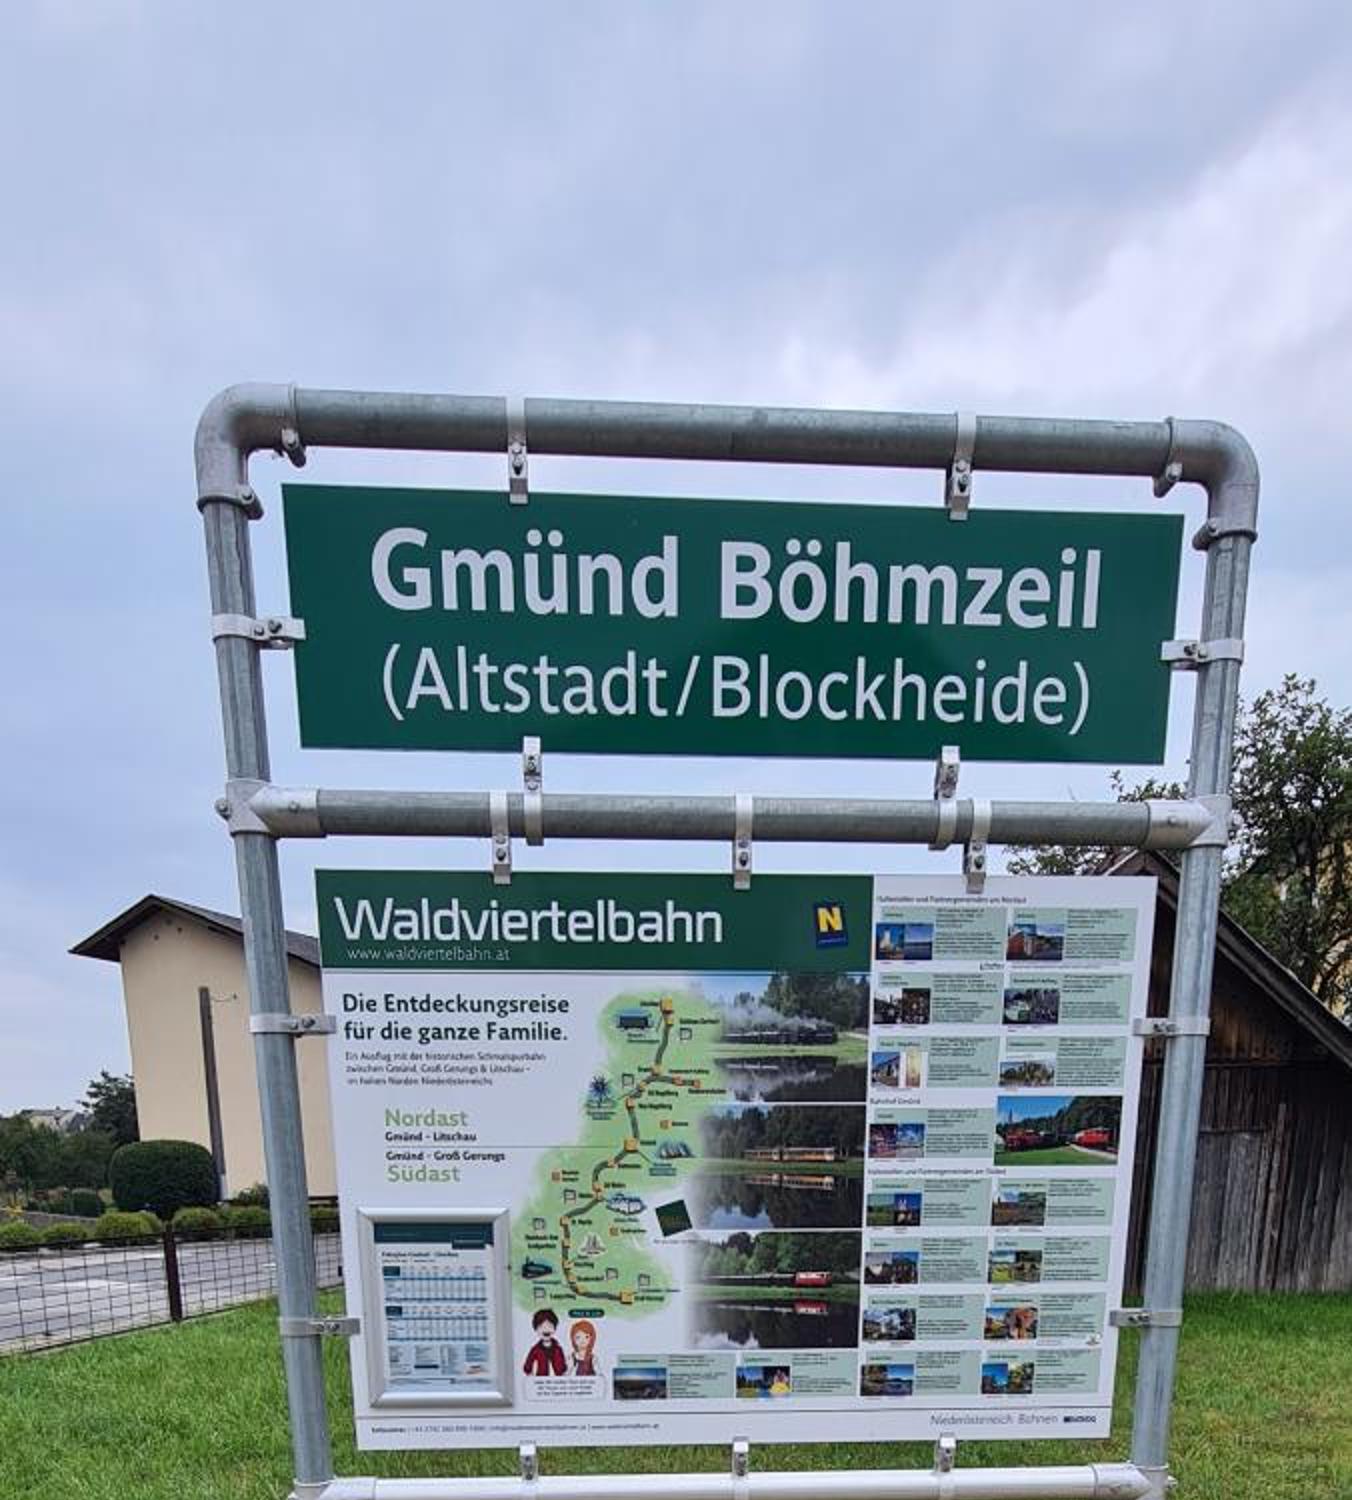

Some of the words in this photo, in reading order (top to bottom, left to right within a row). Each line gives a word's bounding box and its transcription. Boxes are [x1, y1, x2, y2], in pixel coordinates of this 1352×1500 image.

[370, 526, 680, 619] Gmünd
[720, 538, 1101, 629] Böhmzeil
[333, 896, 723, 943] Waldviertelbahn
[817, 906, 843, 933] N
[346, 946, 511, 962] www.waldviertelbahn.at
[343, 993, 377, 1013] Die
[383, 993, 569, 1018] Entdeckungsreise
[344, 1021, 374, 1040] für
[380, 1021, 412, 1041] die
[418, 1025, 480, 1045] ganze
[487, 1021, 568, 1041] Familie.
[385, 1109, 468, 1127] Nordast
[385, 1131, 423, 1142] Gmünd
[433, 1131, 477, 1142] Litschau
[386, 1151, 424, 1161] Gmünd
[434, 1151, 460, 1161] Groß
[463, 1151, 506, 1163] Gerungs
[388, 1163, 461, 1183] Südast
